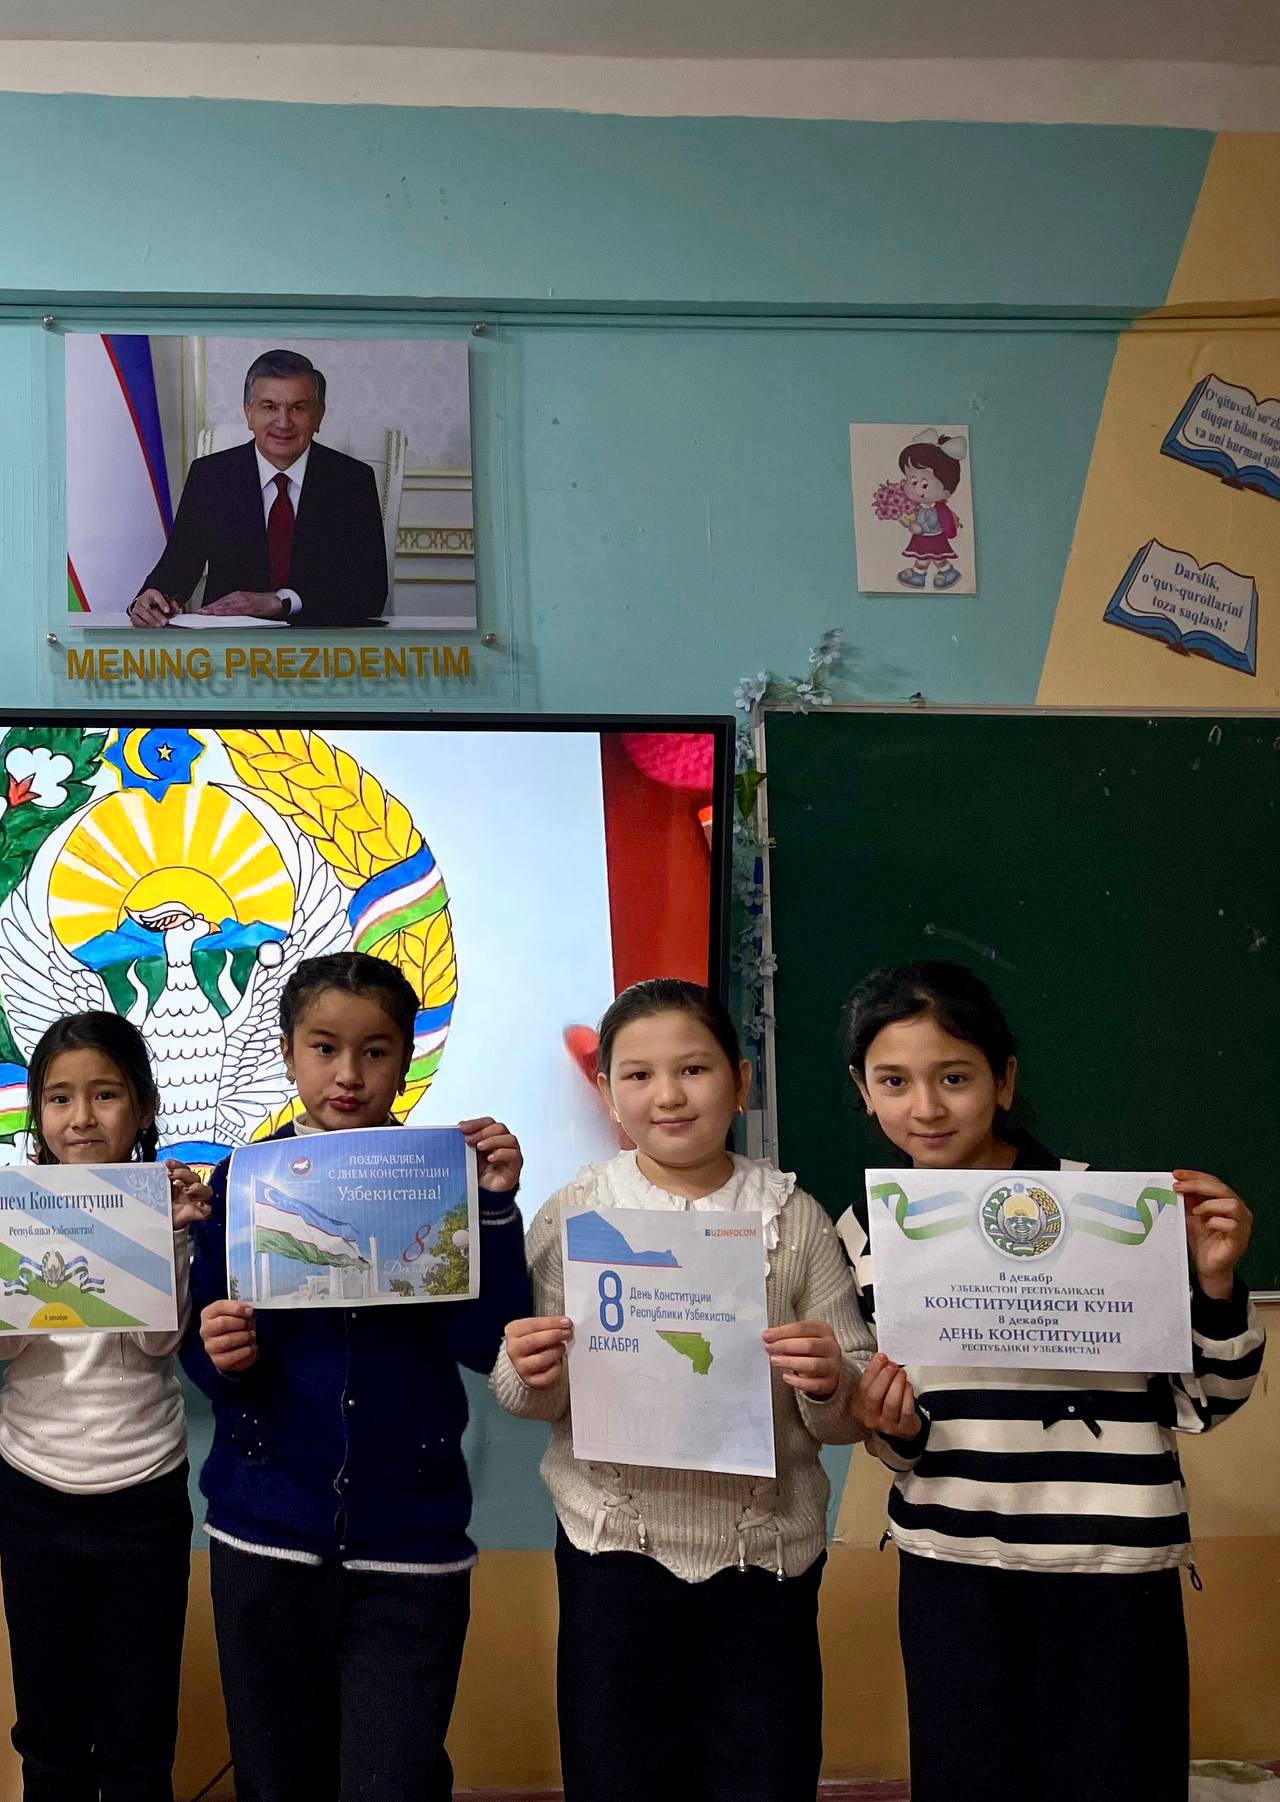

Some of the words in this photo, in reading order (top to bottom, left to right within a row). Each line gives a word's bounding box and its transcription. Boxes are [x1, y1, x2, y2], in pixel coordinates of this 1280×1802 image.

[1201, 407, 1233, 429] diqqat
[1234, 419, 1259, 441] bilan
[1195, 426, 1206, 438] va
[1208, 430, 1226, 447] uni
[1226, 437, 1263, 461] hurmat
[1174, 562, 1220, 592] Darslik,
[1152, 596, 1176, 614] toza
[1179, 606, 1228, 632] saqlash!
[66, 647, 212, 681] MENING
[224, 646, 472, 680] PREZIDENTIM
[349, 1154, 425, 1166] ПОЗДРАВЛЯЕМ
[337, 1168, 369, 1180] ДНЕМ
[370, 1167, 450, 1179] КОНСТИТУЦИИ
[338, 1185, 441, 1201] Узбекистана!
[29, 1191, 124, 1215] Конституции
[9, 1225, 51, 1238] Республики
[402, 1224, 432, 1262] 8
[999, 1272, 1006, 1282] 8
[1009, 1272, 1053, 1284] декабр
[629, 1287, 653, 1301] День
[654, 1289, 712, 1305] Конституции
[950, 1285, 1018, 1294] УЗБЕКИСТОН
[1021, 1286, 1105, 1296] РЕСПУБЛИКАСИ
[598, 1270, 625, 1333] 8
[924, 1296, 1078, 1313] КОНСТИТУЦИЯСИ
[1085, 1300, 1134, 1314] КУНИ
[630, 1305, 683, 1322] Республики
[998, 1315, 1006, 1325] 8
[1009, 1315, 1059, 1327] декабря
[589, 1336, 639, 1353] ДЕКАБРЯ
[939, 1327, 984, 1342] ДЕНЬ
[989, 1329, 1122, 1345] КОНСТИТУЦИИ
[961, 1343, 1030, 1353] РЕСПУБЛИКИ
[1032, 1345, 1101, 1355] УЗБЕКИСТАН
